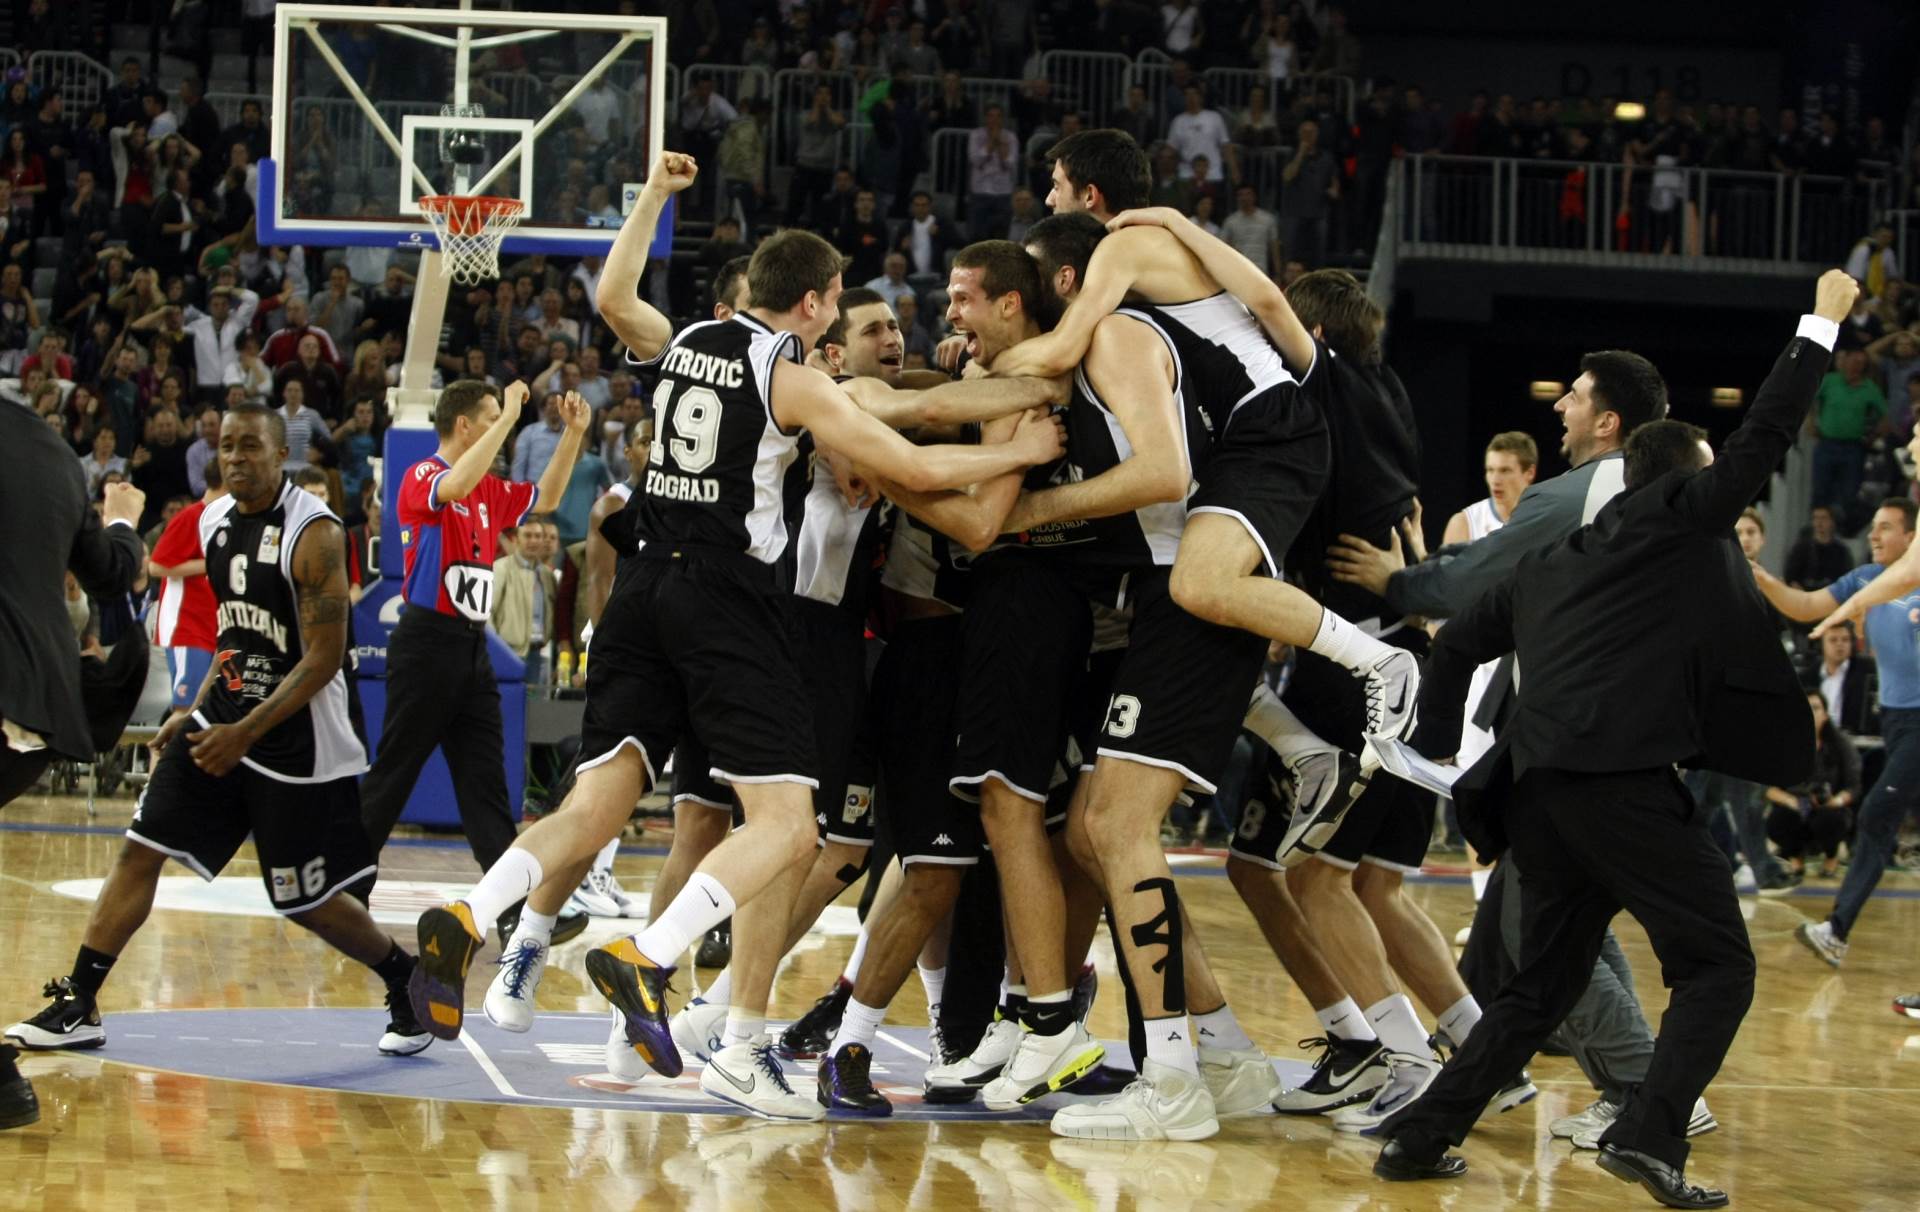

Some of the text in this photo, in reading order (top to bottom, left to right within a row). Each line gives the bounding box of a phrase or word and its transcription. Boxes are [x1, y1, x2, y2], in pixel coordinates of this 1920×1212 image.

[1561, 61, 1594, 97] D
[650, 379, 723, 474] 19
[229, 553, 248, 595] 6
[302, 856, 326, 897] 6
